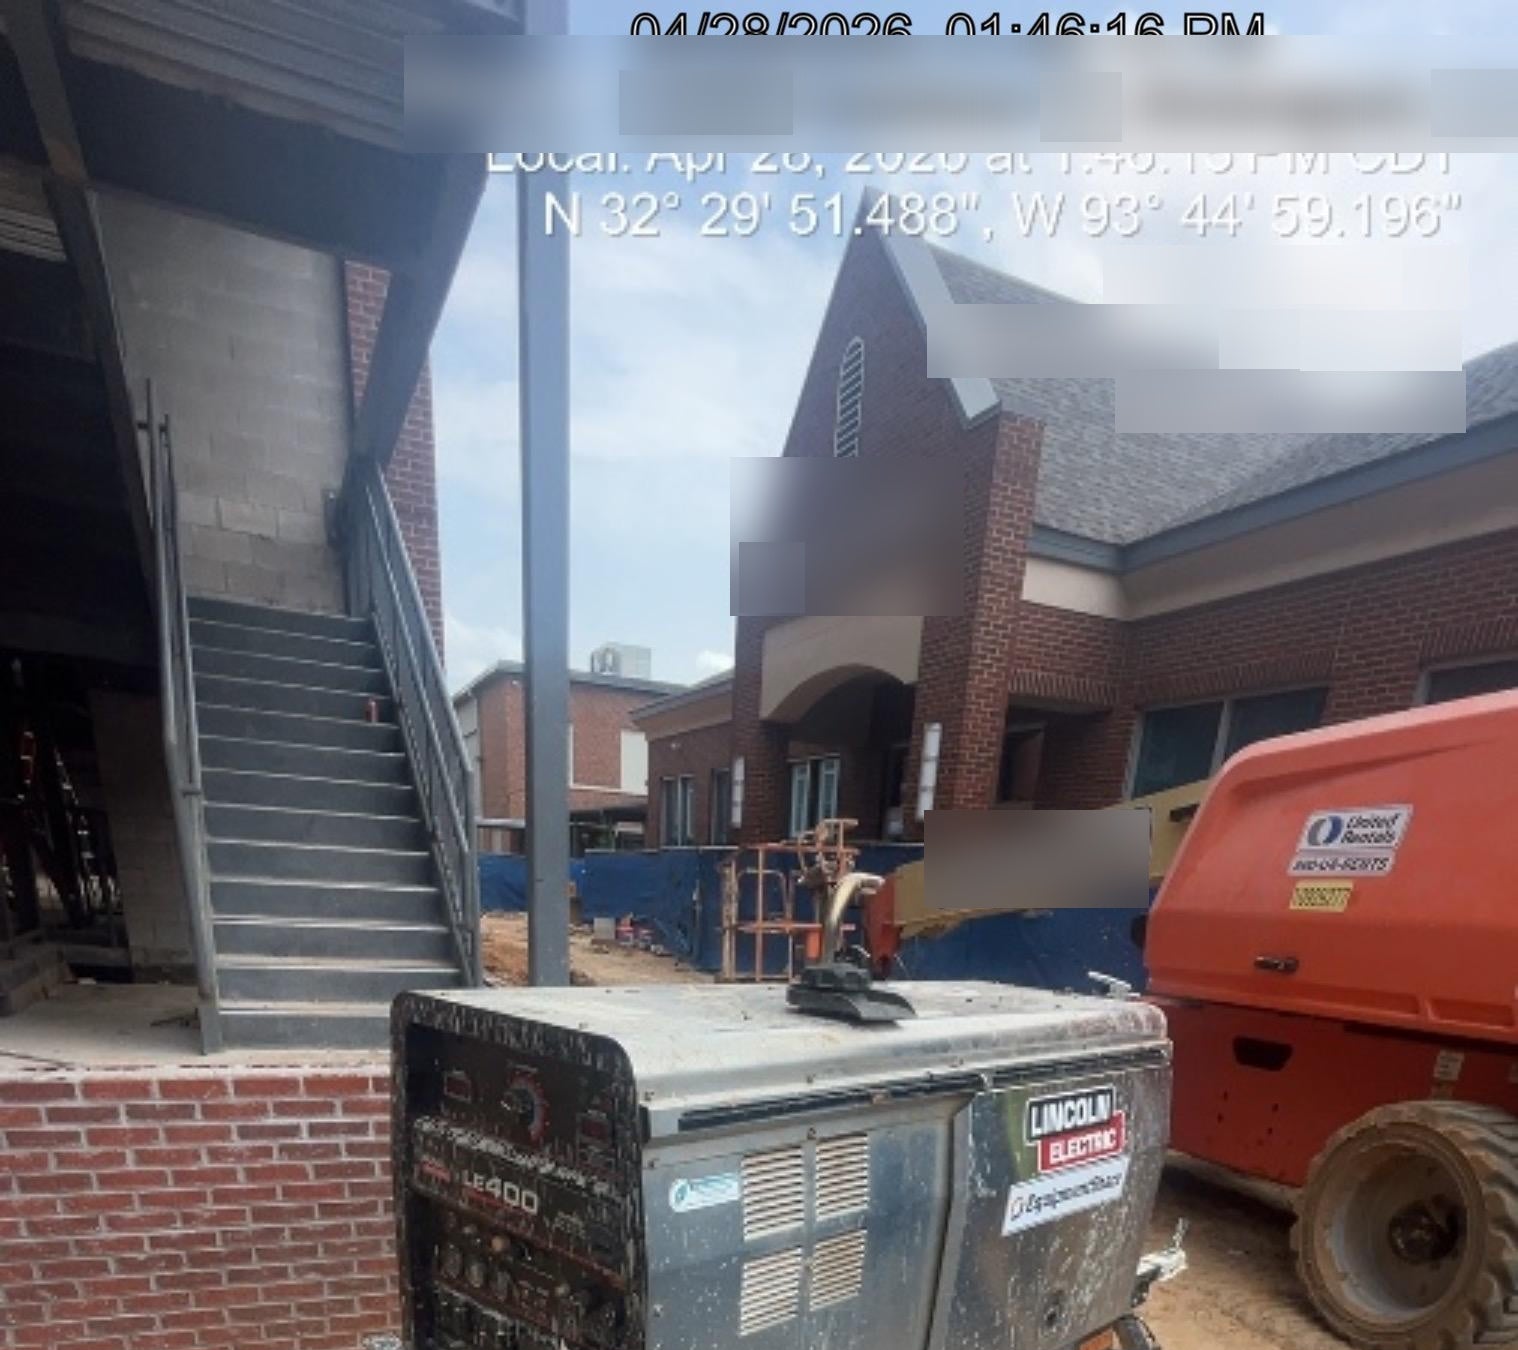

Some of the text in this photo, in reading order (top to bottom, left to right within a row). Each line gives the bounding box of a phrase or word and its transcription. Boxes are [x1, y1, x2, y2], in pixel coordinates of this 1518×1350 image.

[1345, 812, 1402, 829] United
[1340, 829, 1397, 845] Rentals
[1031, 1091, 1113, 1138] LINCOLN
[1049, 1128, 1118, 1165] ELECTRIC
